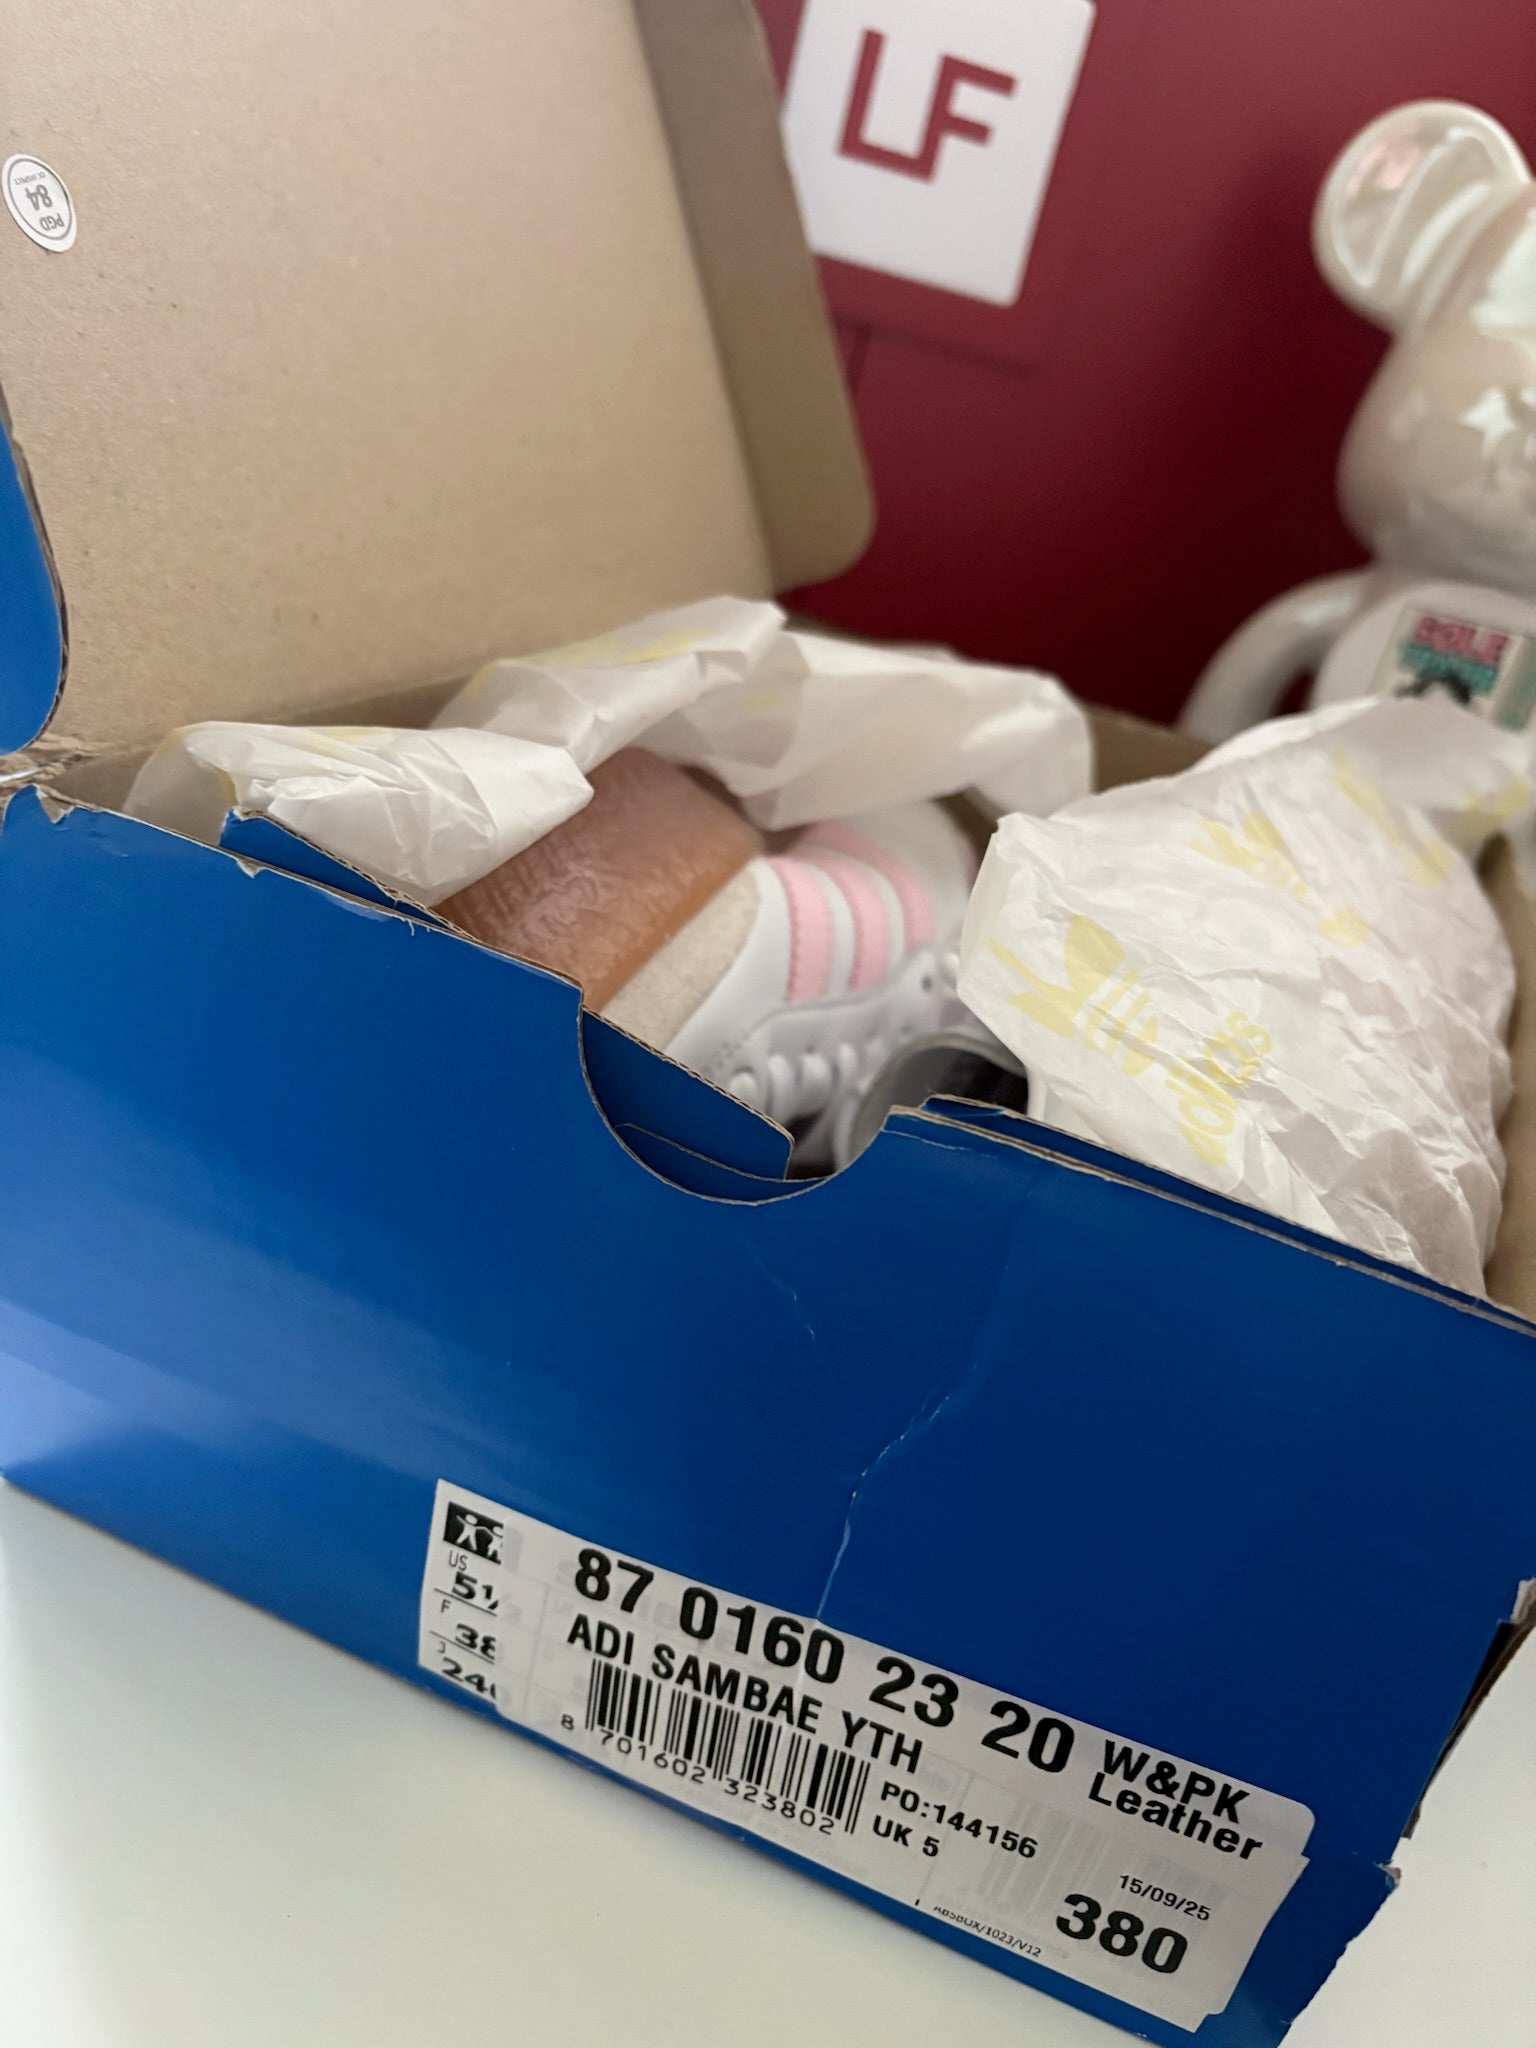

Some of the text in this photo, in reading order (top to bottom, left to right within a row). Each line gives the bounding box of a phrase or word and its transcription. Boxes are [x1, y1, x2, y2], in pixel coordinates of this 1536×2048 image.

[837, 26, 1018, 184] LF
[24, 184, 53, 211] 84
[39, 213, 65, 231] PGD
[449, 1550, 467, 1571] US
[440, 1599, 451, 1614] F
[441, 1657, 496, 1699] 24
[567, 1613, 923, 1774] ADI SAMBAE YTH
[573, 1547, 1250, 1824] 87 0160 23 20 W&PK
[561, 1714, 835, 1835] 8 701602 323802
[872, 1815, 940, 1857] UK 5
[880, 1780, 1039, 1859] PO:144156
[1088, 1772, 1263, 1860] Leather
[1119, 1874, 1212, 1922] 15/09/25
[1056, 1893, 1188, 1974] 380
